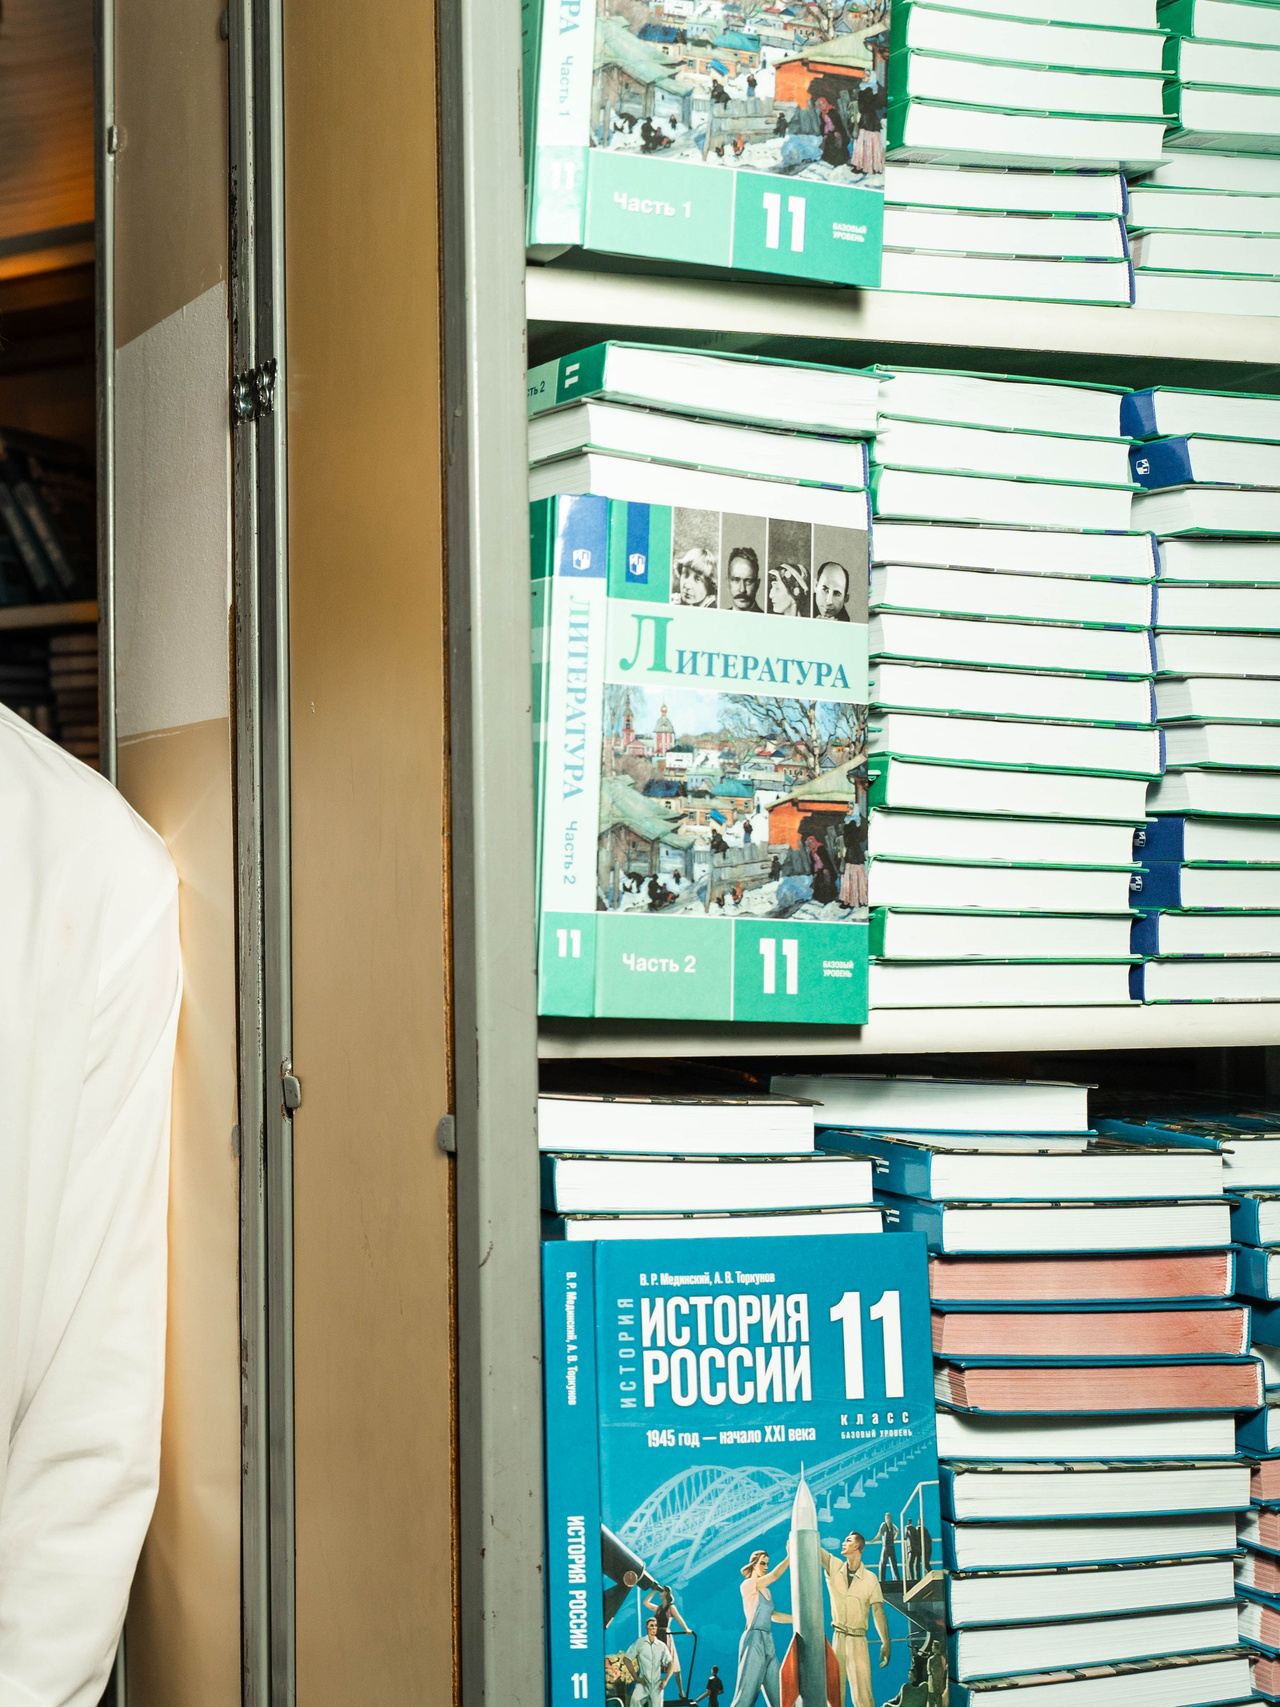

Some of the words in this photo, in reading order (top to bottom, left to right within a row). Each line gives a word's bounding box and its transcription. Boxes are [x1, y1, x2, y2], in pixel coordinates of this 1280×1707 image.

[551, 162, 576, 190] 11
[613, 192, 676, 217] Часть
[681, 201, 692, 218] 1
[763, 192, 806, 253] 11
[832, 221, 867, 234] БАЗОВЫЙ
[832, 231, 865, 243] УРОВЕНЬ
[563, 595, 590, 801] ЛИТЕРАТУРА
[564, 820, 578, 870] Часть
[556, 929, 581, 958] 11
[622, 953, 680, 973] Часть
[683, 955, 697, 973] 2
[759, 937, 799, 995] 11
[822, 960, 854, 970] БАЗОВЫЙ
[823, 969, 853, 978] УРОВЕНЬ
[566, 1271, 577, 1281] В.
[566, 1282, 577, 1290] Р.
[640, 1273, 649, 1286] В.
[650, 1273, 659, 1286] Р.
[660, 1271, 713, 1287] Мединский,
[714, 1271, 723, 1285] А.
[724, 1271, 734, 1284] В.
[735, 1270, 776, 1286] Торкунов
[640, 1292, 810, 1348] ИСТОРИЯ
[566, 1344, 578, 1354] А.
[617, 1298, 637, 1409] ИСТОРИЯ
[829, 1290, 905, 1400] 11
[566, 1355, 578, 1364] В.
[565, 1365, 579, 1406] Торкунов
[642, 1345, 812, 1408] РОССИИ
[646, 1429, 676, 1448] 1945
[678, 1432, 700, 1448] год
[719, 1429, 762, 1444] начало
[788, 1427, 816, 1442] века
[841, 1429, 877, 1439] БАЗОВЫЙ
[880, 1429, 913, 1438] УРОВЕНЬ
[566, 1515, 587, 1584] ИСТОРИЯ
[568, 1590, 588, 1649] РОССИИ
[571, 1672, 588, 1699] 11
